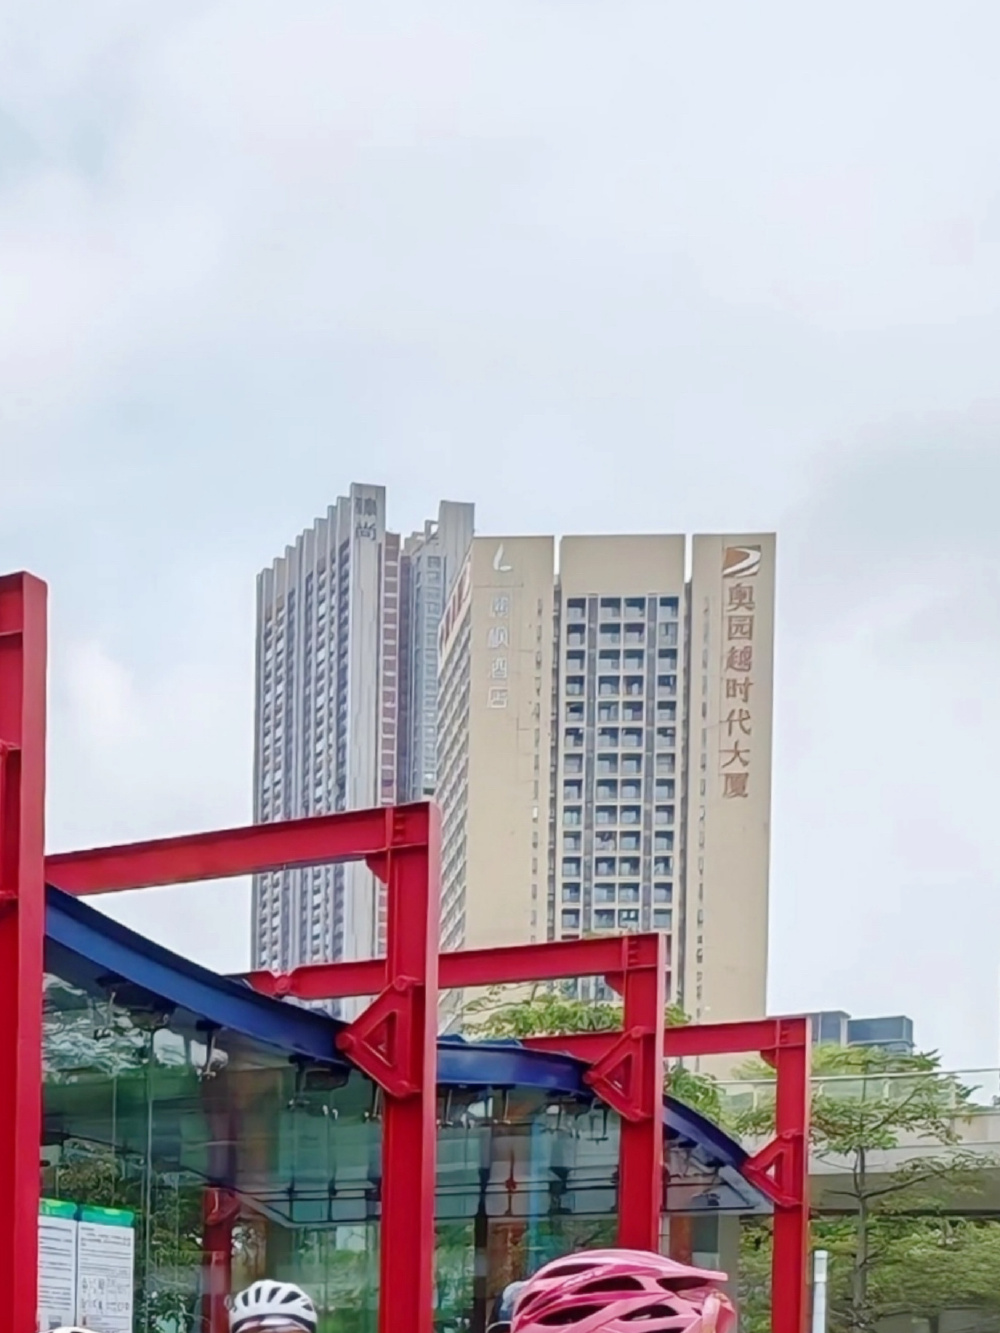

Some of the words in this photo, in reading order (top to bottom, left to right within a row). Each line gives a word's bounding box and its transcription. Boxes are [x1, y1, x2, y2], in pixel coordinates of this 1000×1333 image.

[719, 582, 756, 799] 奥园越时代大厦
